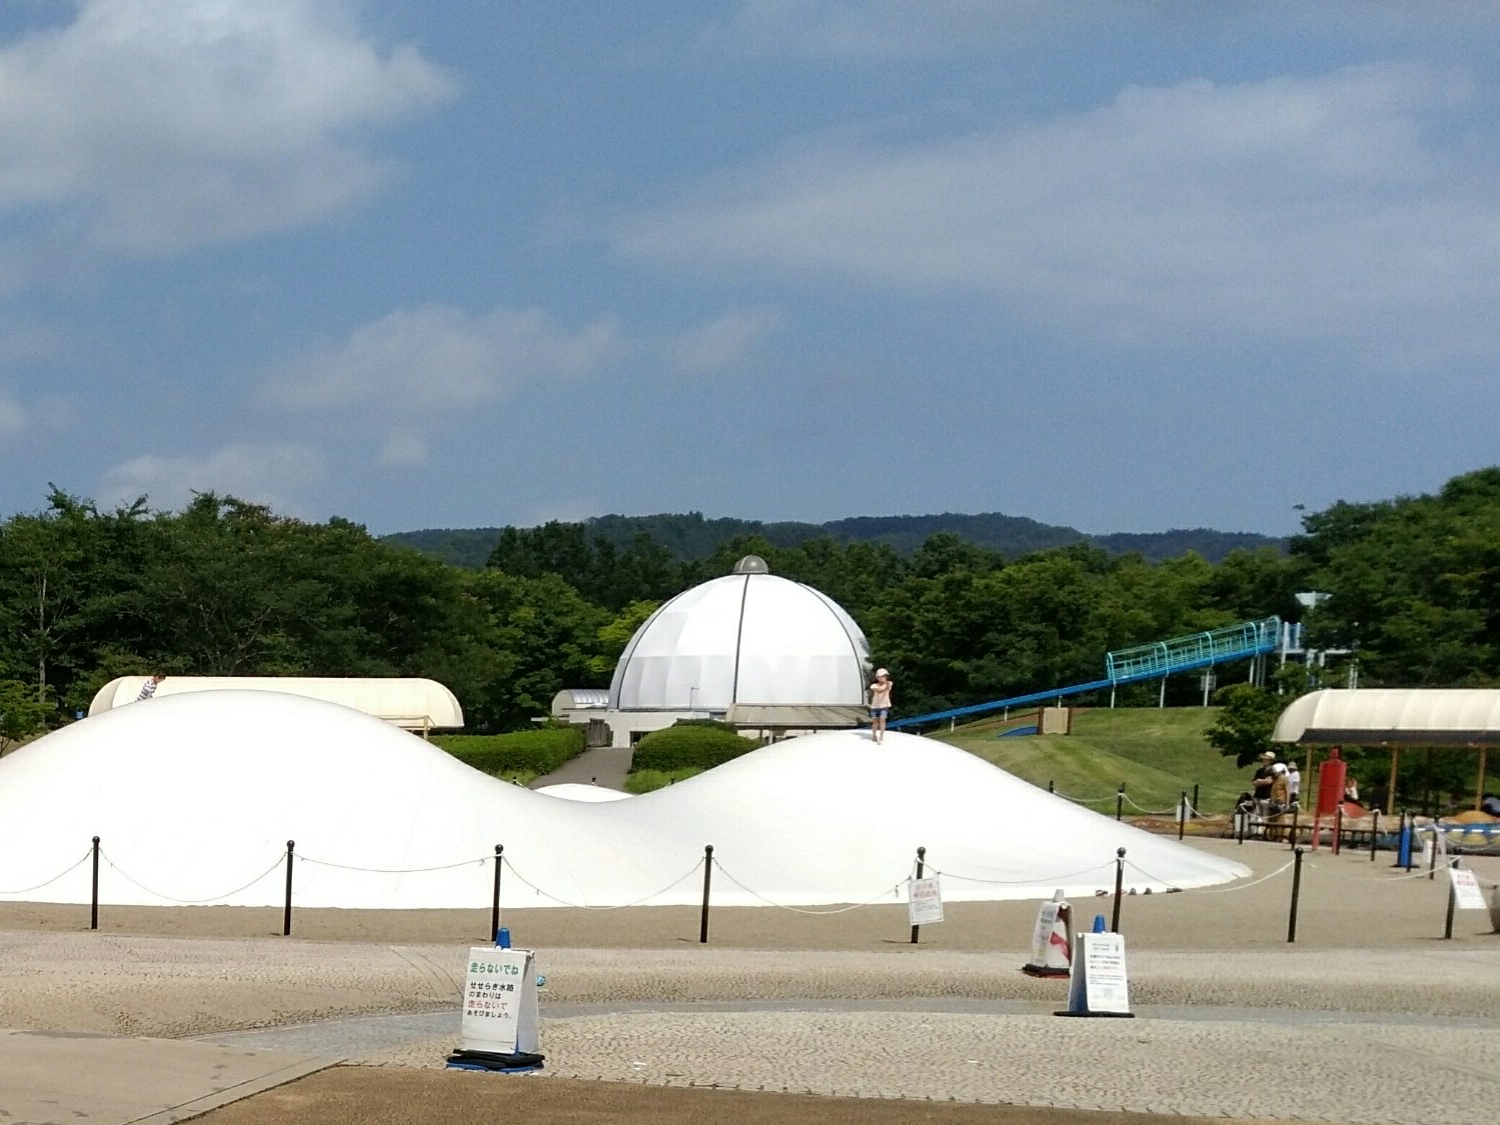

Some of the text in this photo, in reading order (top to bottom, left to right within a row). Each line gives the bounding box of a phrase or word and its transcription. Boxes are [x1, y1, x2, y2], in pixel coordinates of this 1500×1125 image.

[470, 962, 519, 975] 走らないでね
[470, 982, 514, 992] せせらぎ水路
[469, 991, 501, 999] のまわりは
[468, 1000, 508, 1010] 走らないで
[467, 1010, 512, 1019] あそびましょう。
